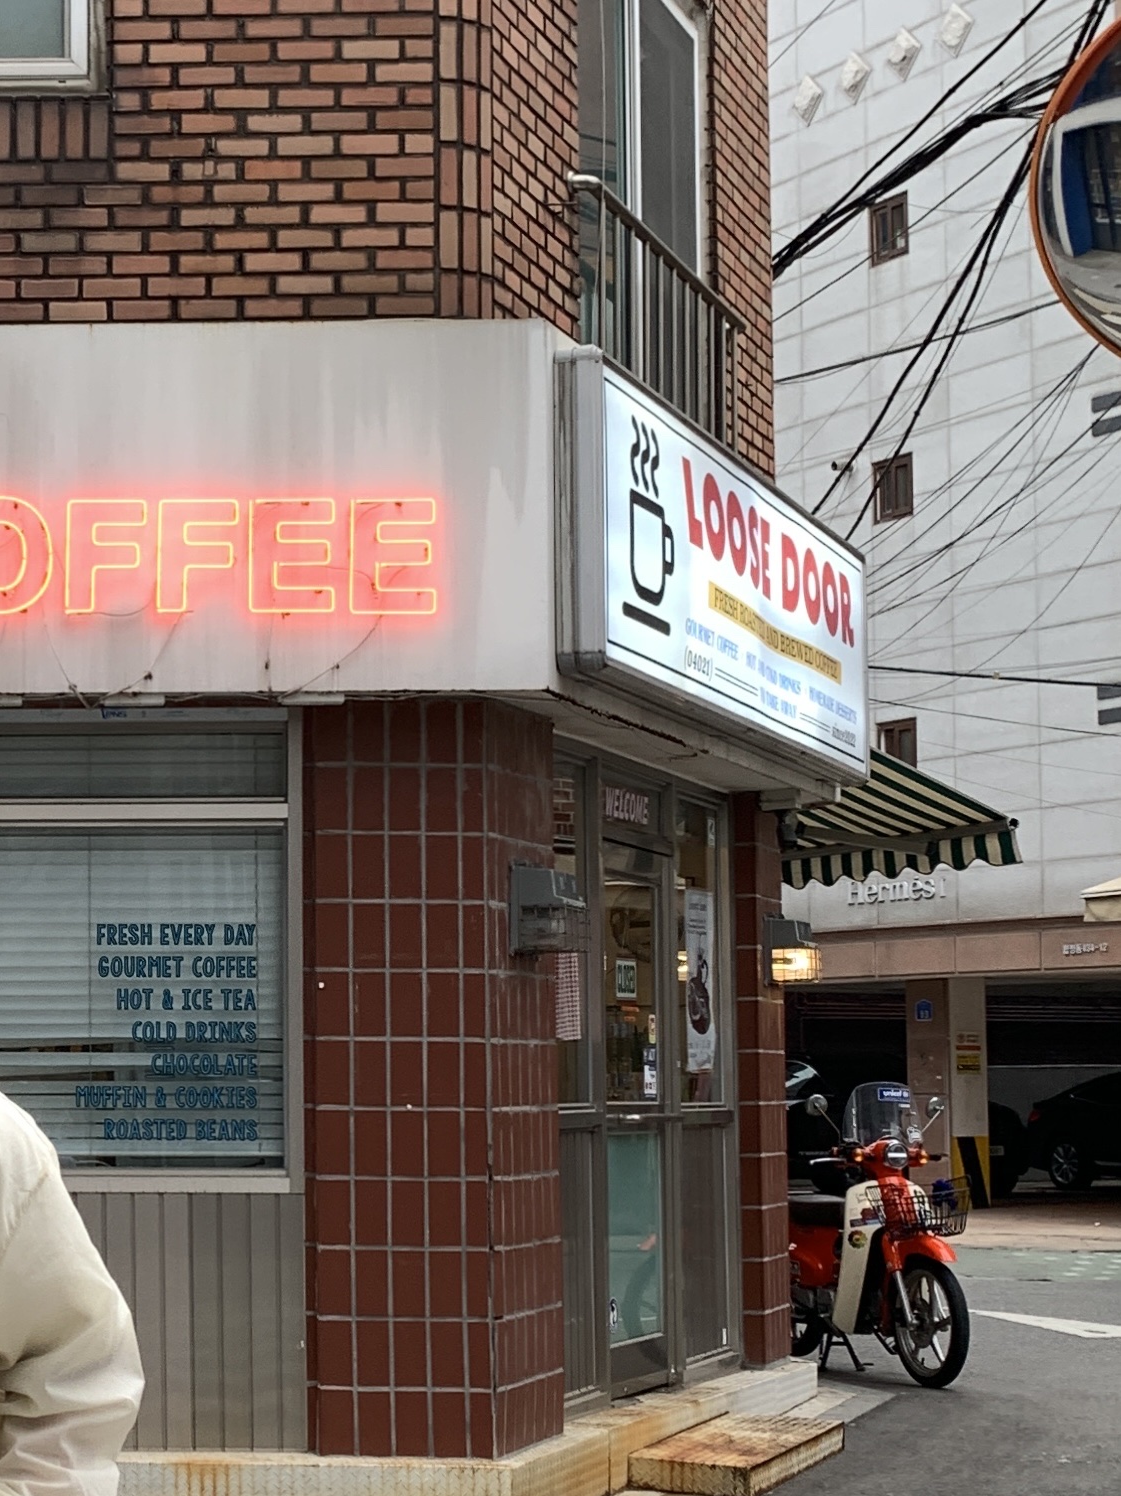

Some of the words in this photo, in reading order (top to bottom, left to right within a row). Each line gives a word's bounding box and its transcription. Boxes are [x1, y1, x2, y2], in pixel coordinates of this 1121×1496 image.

[682, 456, 772, 600] LOOSE
[781, 532, 855, 648] DOOR
[714, 588, 738, 618] FRESH
[781, 635, 813, 665] BREWED
[685, 618, 715, 647] GOURMET
[717, 636, 739, 661] COFFEE
[684, 645, 713, 681] (04021)
[605, 786, 649, 825] WELCOME
[96, 924, 152, 946] FRESH
[160, 924, 216, 946] EVERY
[224, 924, 256, 946] DAY
[98, 956, 184, 978] GOURMET
[192, 956, 257, 978] COFFEE
[116, 988, 153, 1010] HOT
[162, 989, 174, 1010] &
[182, 988, 213, 1010] ICE
[220, 988, 256, 1010] TEA
[132, 1021, 176, 1043] COLD
[185, 1021, 257, 1044] DRINKS
[152, 1054, 258, 1076] CHOCOLATE
[75, 1086, 146, 1108] MUFFIN
[154, 1086, 167, 1108] &
[174, 1086, 257, 1108] COOKIES
[104, 1118, 187, 1140] ROASTED
[195, 1119, 258, 1141] BEANS
